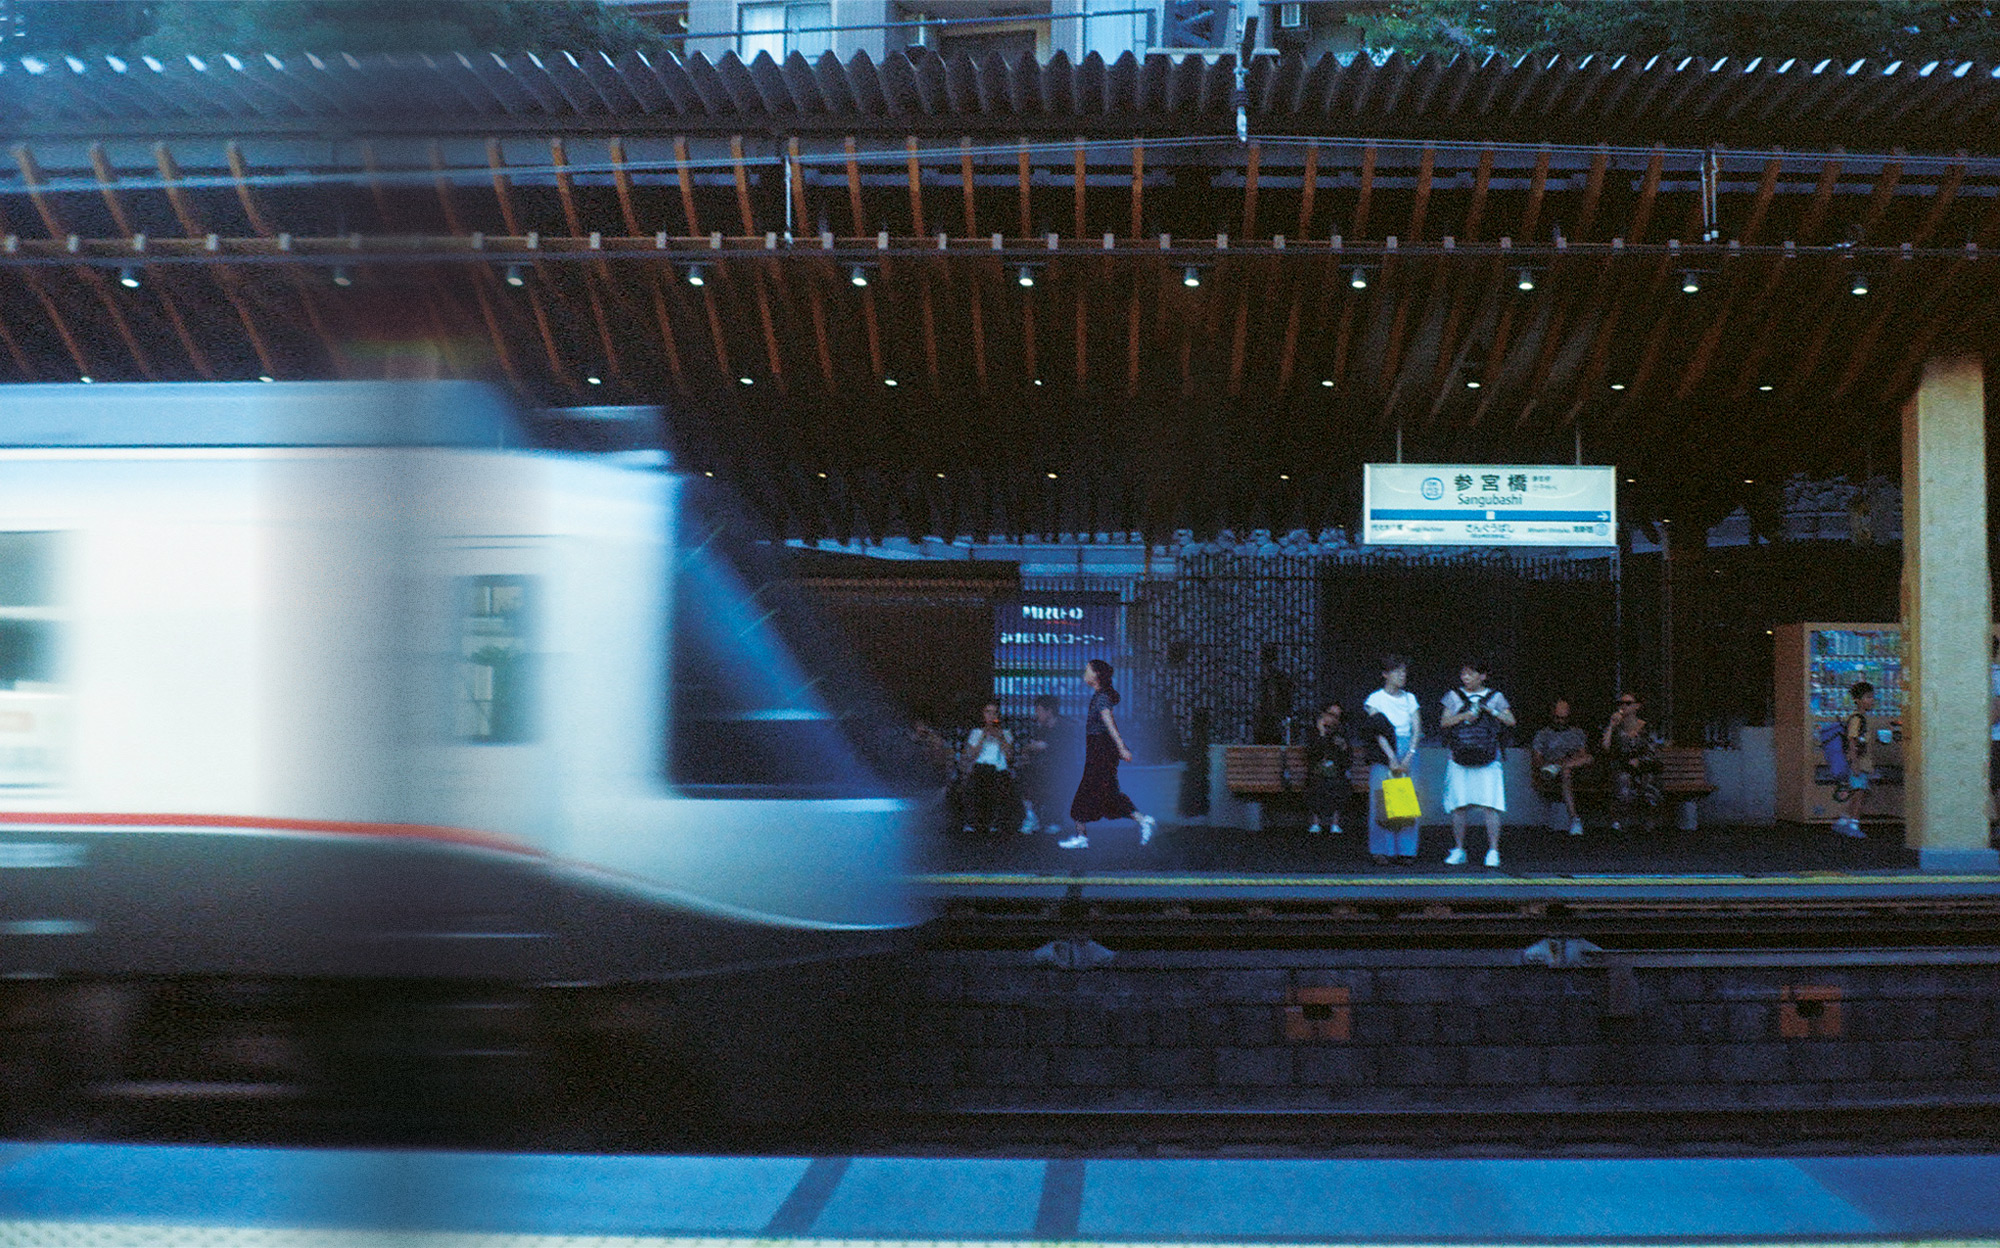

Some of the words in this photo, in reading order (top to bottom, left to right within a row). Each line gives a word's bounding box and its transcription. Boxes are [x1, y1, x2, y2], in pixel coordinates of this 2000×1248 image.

[1454, 473, 1527, 492] 参宮橋
[1457, 493, 1522, 507] Sangubashi
